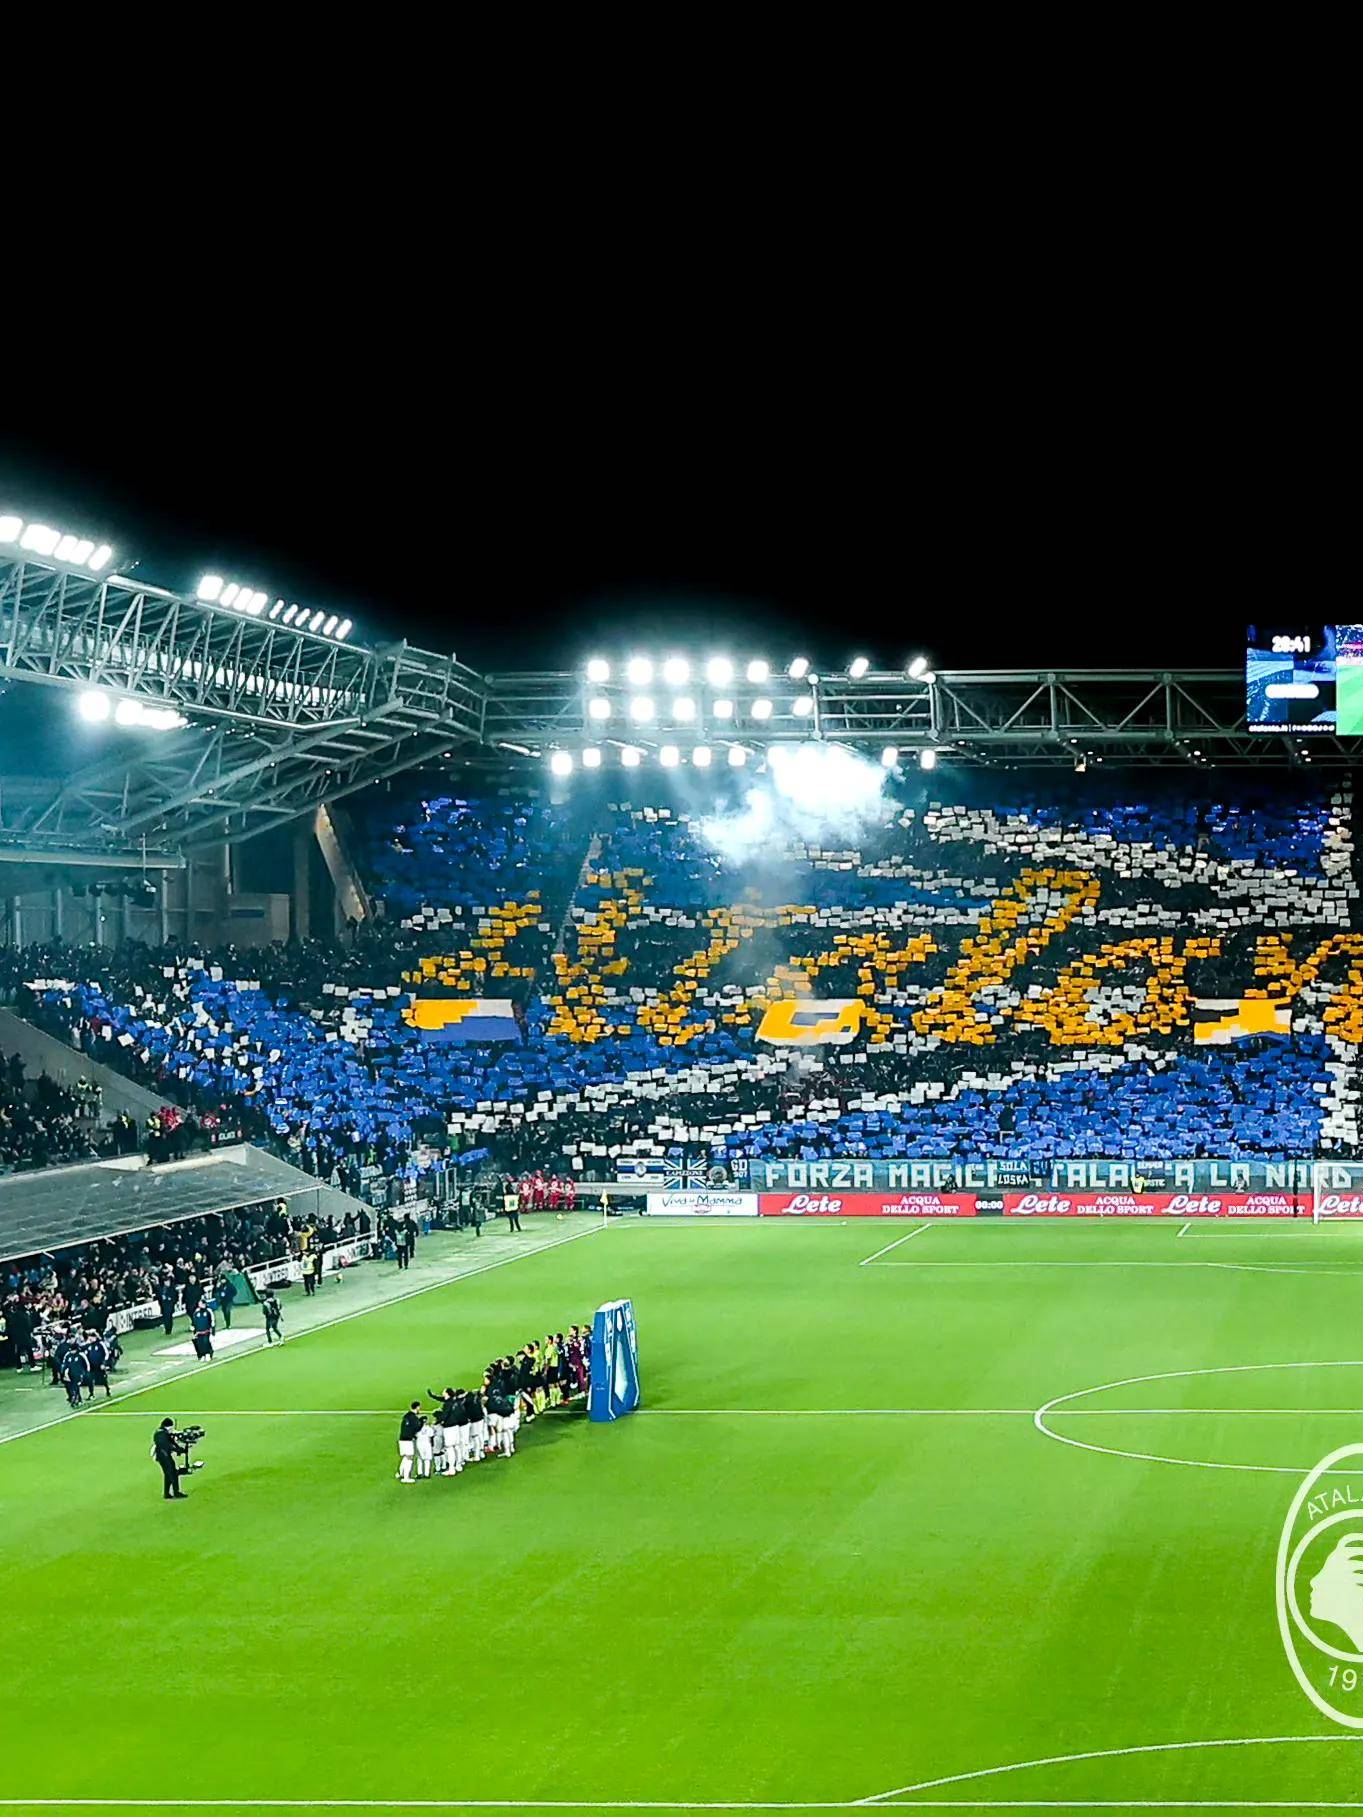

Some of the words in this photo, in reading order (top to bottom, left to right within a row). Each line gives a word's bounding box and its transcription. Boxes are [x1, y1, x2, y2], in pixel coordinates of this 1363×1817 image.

[765, 1162, 874, 1188] FORZA
[781, 1194, 842, 1214] Lete
[900, 1195, 940, 1206] ACQUA
[975, 1200, 1003, 1209] 00:00
[1010, 1194, 1071, 1214] Lete
[1095, 1196, 1135, 1206] ACQUA
[1161, 1195, 1221, 1214] Lete
[1247, 1195, 1286, 1206] ACQUA
[882, 1205, 921, 1214] DELLO
[921, 1205, 959, 1214] SPORT
[1077, 1205, 1114, 1214] DELLO
[1117, 1205, 1154, 1214] SPORT
[1228, 1205, 1266, 1214] DELLO
